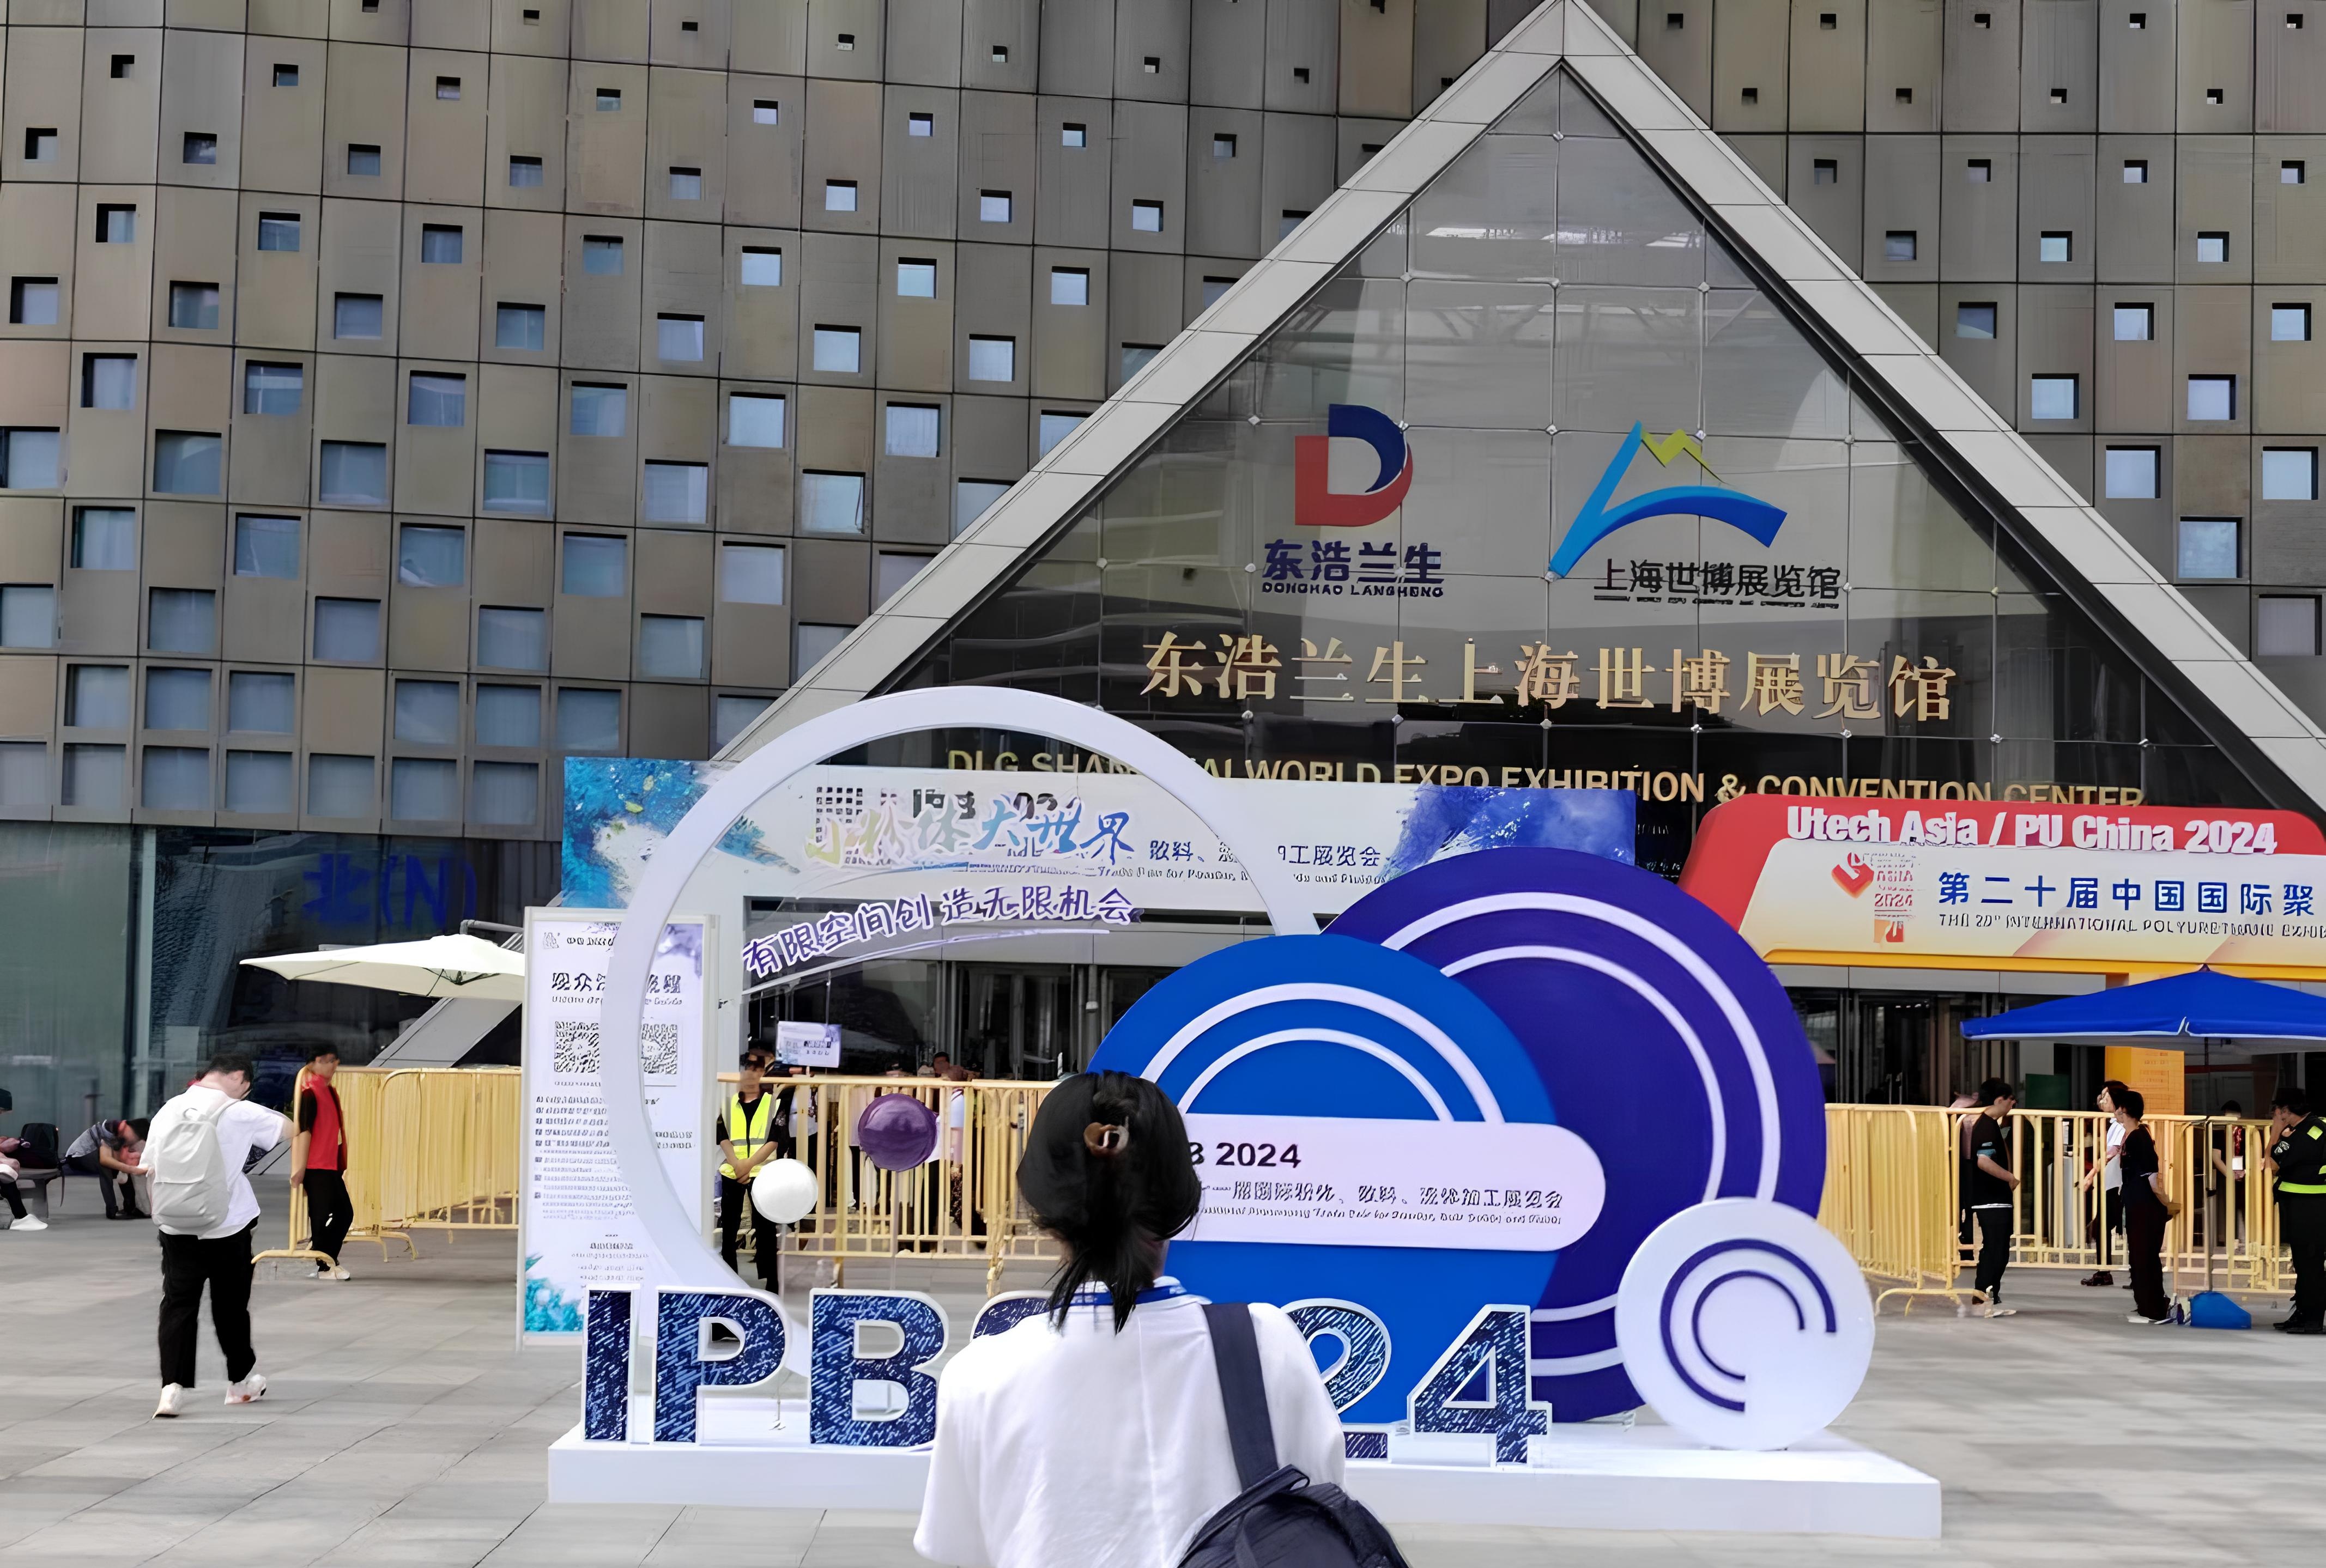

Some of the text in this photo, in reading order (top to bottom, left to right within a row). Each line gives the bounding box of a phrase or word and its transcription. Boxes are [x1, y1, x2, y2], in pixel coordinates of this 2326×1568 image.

[1263, 538, 1445, 584] 东浩兰生
[1594, 558, 1840, 599] 上海世博展览馆
[1140, 630, 1956, 721] 东浩兰生上海世博展览馆
[1245, 759, 1381, 782] WORLD
[1395, 764, 1491, 787] EXPO
[1501, 767, 1705, 802] EXHIBITION
[1714, 774, 1746, 804] &
[1756, 775, 1992, 802] CONVENTION
[1787, 806, 1891, 843] Utech
[1899, 811, 1978, 846] Asia
[2015, 814, 2063, 847] PU
[2071, 815, 2174, 851] China
[2184, 820, 2277, 854] 2024
[1938, 872, 2315, 916] 第二十届中国国际聚
[742, 885, 1133, 979] 有限空间创造无限机会
[1215, 1142, 1301, 1169] 2024
[581, 1285, 949, 1450] IPB
